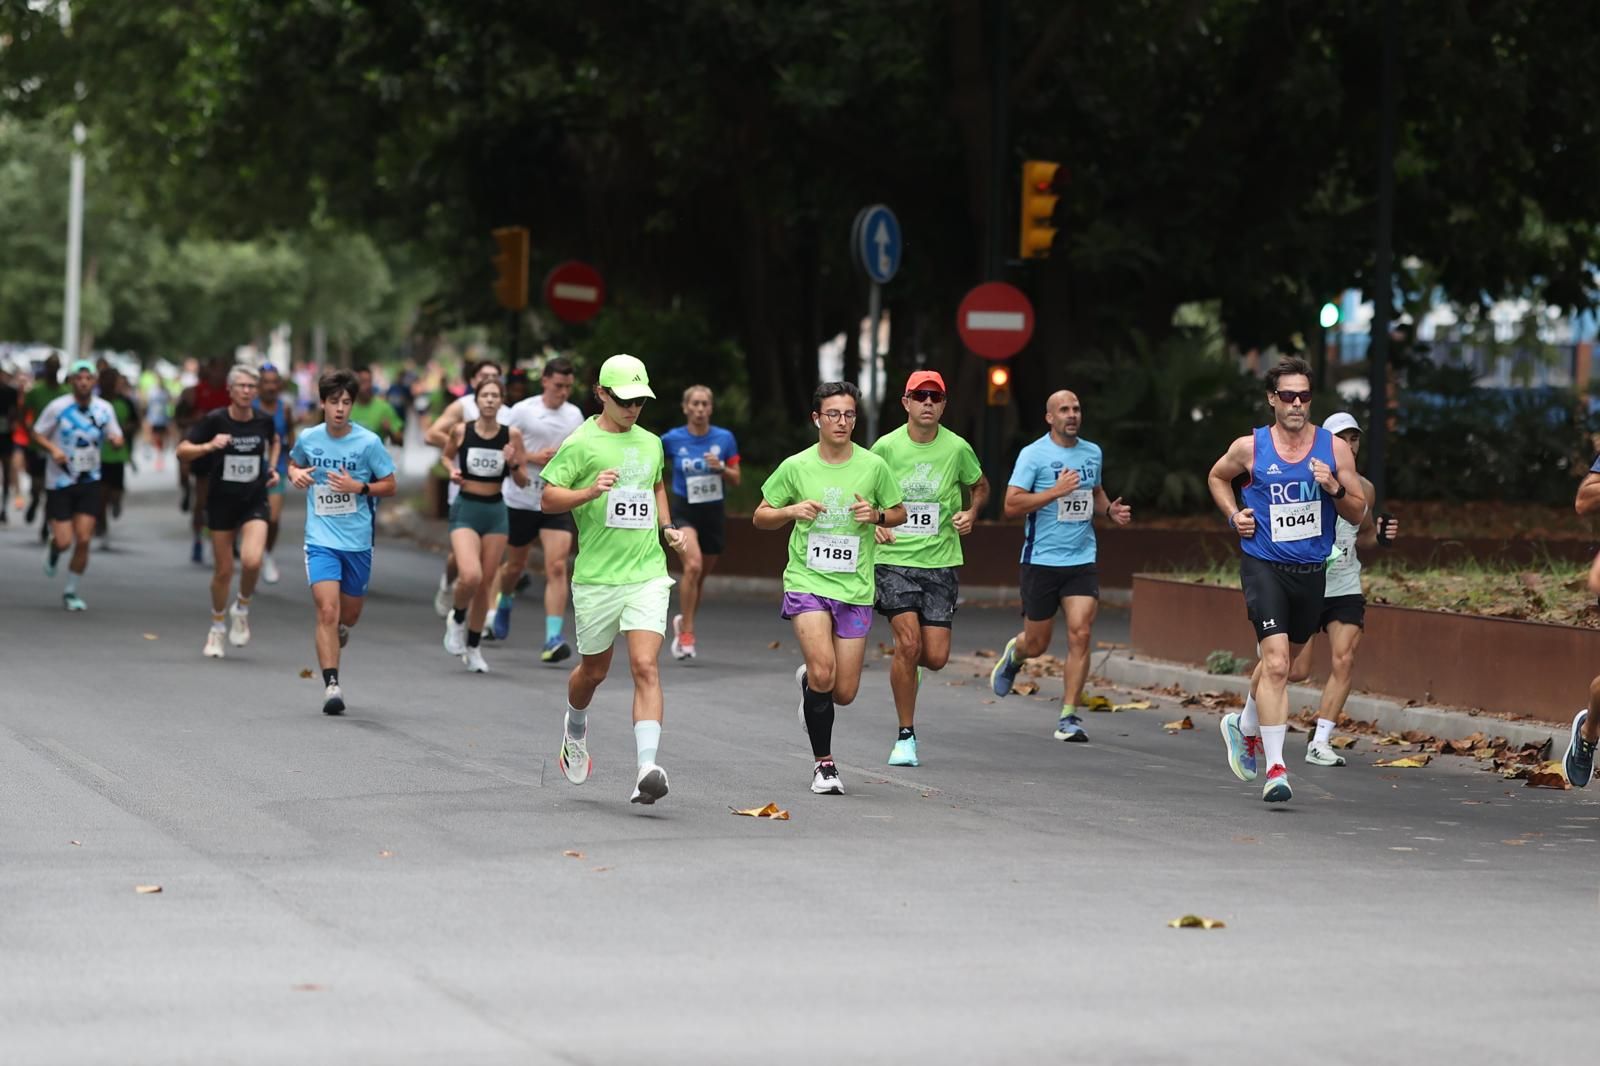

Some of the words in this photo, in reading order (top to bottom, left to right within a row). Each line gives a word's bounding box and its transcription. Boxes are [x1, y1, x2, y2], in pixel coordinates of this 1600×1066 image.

[472, 457, 498, 470] 302
[317, 493, 351, 505] 1030
[1269, 481, 1321, 505] RCM
[614, 502, 649, 517] 619
[1063, 500, 1089, 512] 767
[904, 513, 932, 526] 18
[1275, 512, 1316, 528] 1044
[812, 546, 853, 561] 1189
